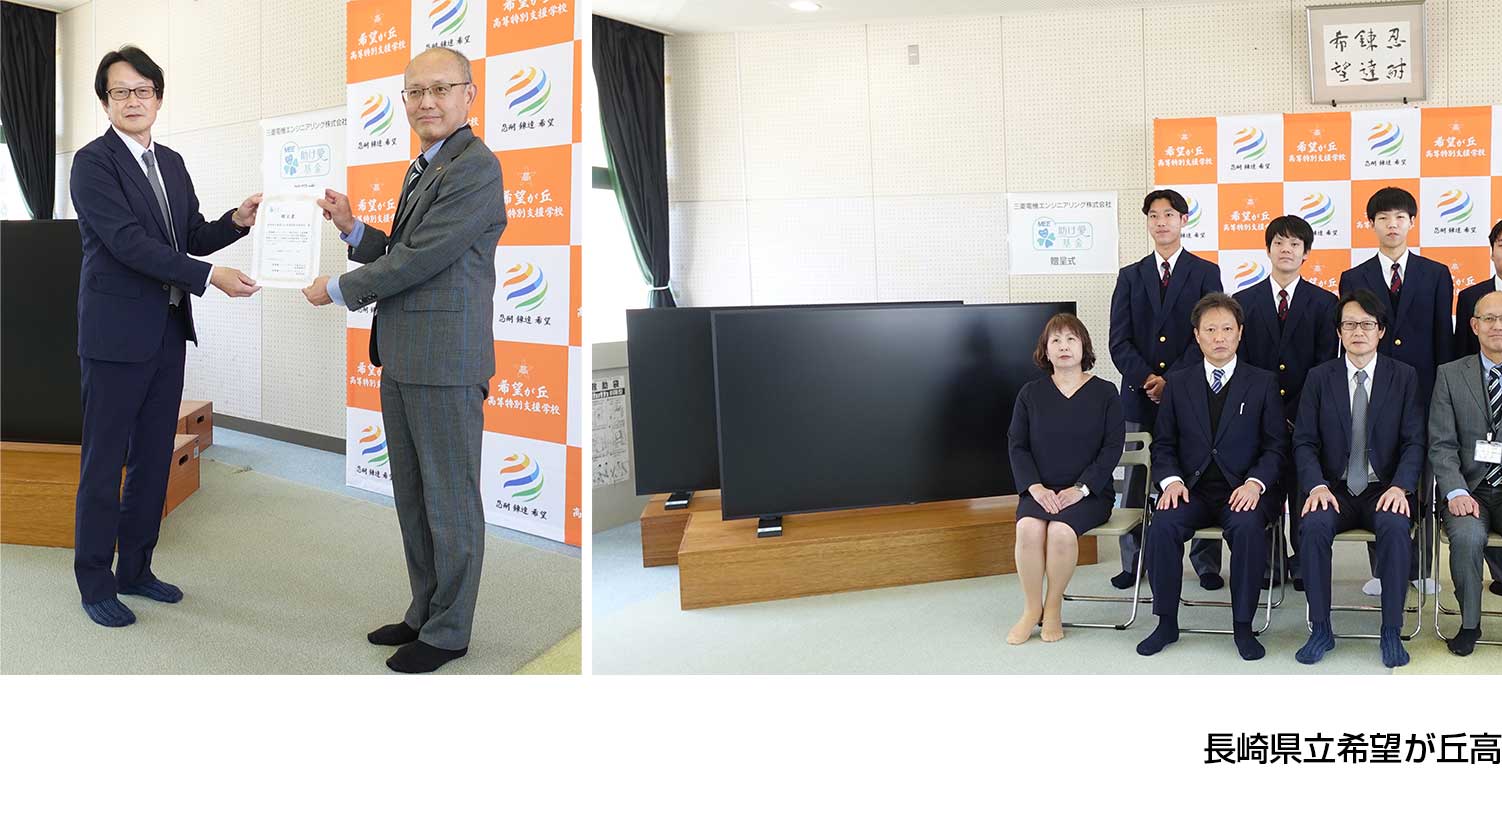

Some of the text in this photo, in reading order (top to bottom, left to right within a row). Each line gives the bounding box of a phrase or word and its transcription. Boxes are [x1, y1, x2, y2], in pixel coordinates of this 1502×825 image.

[358, 27, 398, 46] 希望が丘
[1329, 30, 1351, 82] 希望
[1297, 141, 1337, 152] 希望が丘
[1433, 136, 1477, 148] 希望が丘
[1165, 146, 1204, 157] 希望が丘
[357, 198, 395, 213] 希望が丘
[507, 207, 564, 219] 特別支援学校
[1231, 211, 1270, 221] 希望が丘
[498, 379, 549, 399] 希望が丘
[488, 395, 561, 416] 高等特別支援学校
